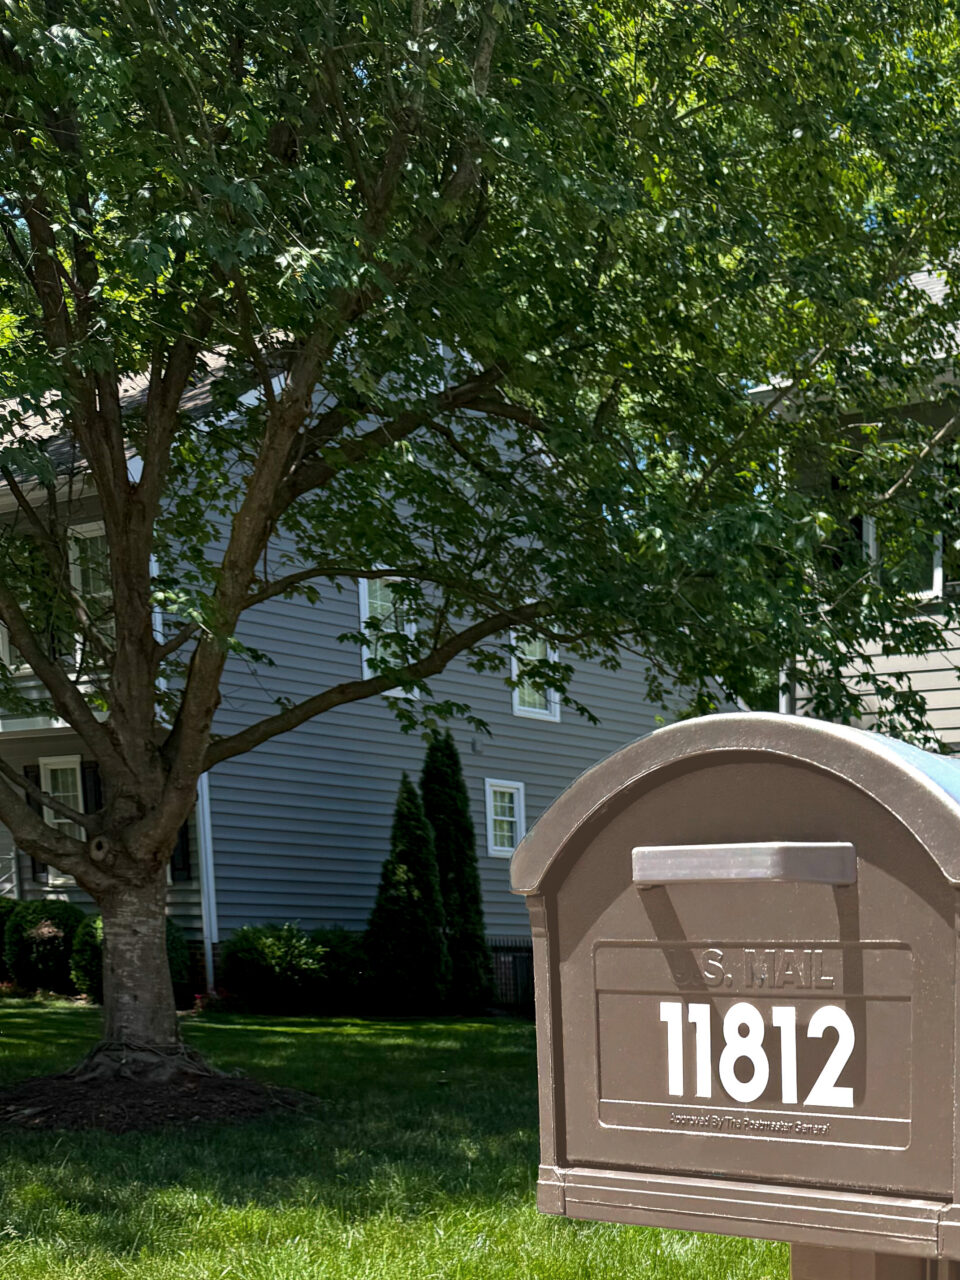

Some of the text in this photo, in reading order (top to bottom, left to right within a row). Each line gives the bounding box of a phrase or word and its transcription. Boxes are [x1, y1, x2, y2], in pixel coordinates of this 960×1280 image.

[744, 948, 834, 989] MAIL
[659, 1001, 856, 1108] 11812
[670, 1112, 710, 1128] Approved
[711, 1115, 724, 1131] By
[724, 1116, 741, 1131] The
[743, 1117, 794, 1134] Postmaster
